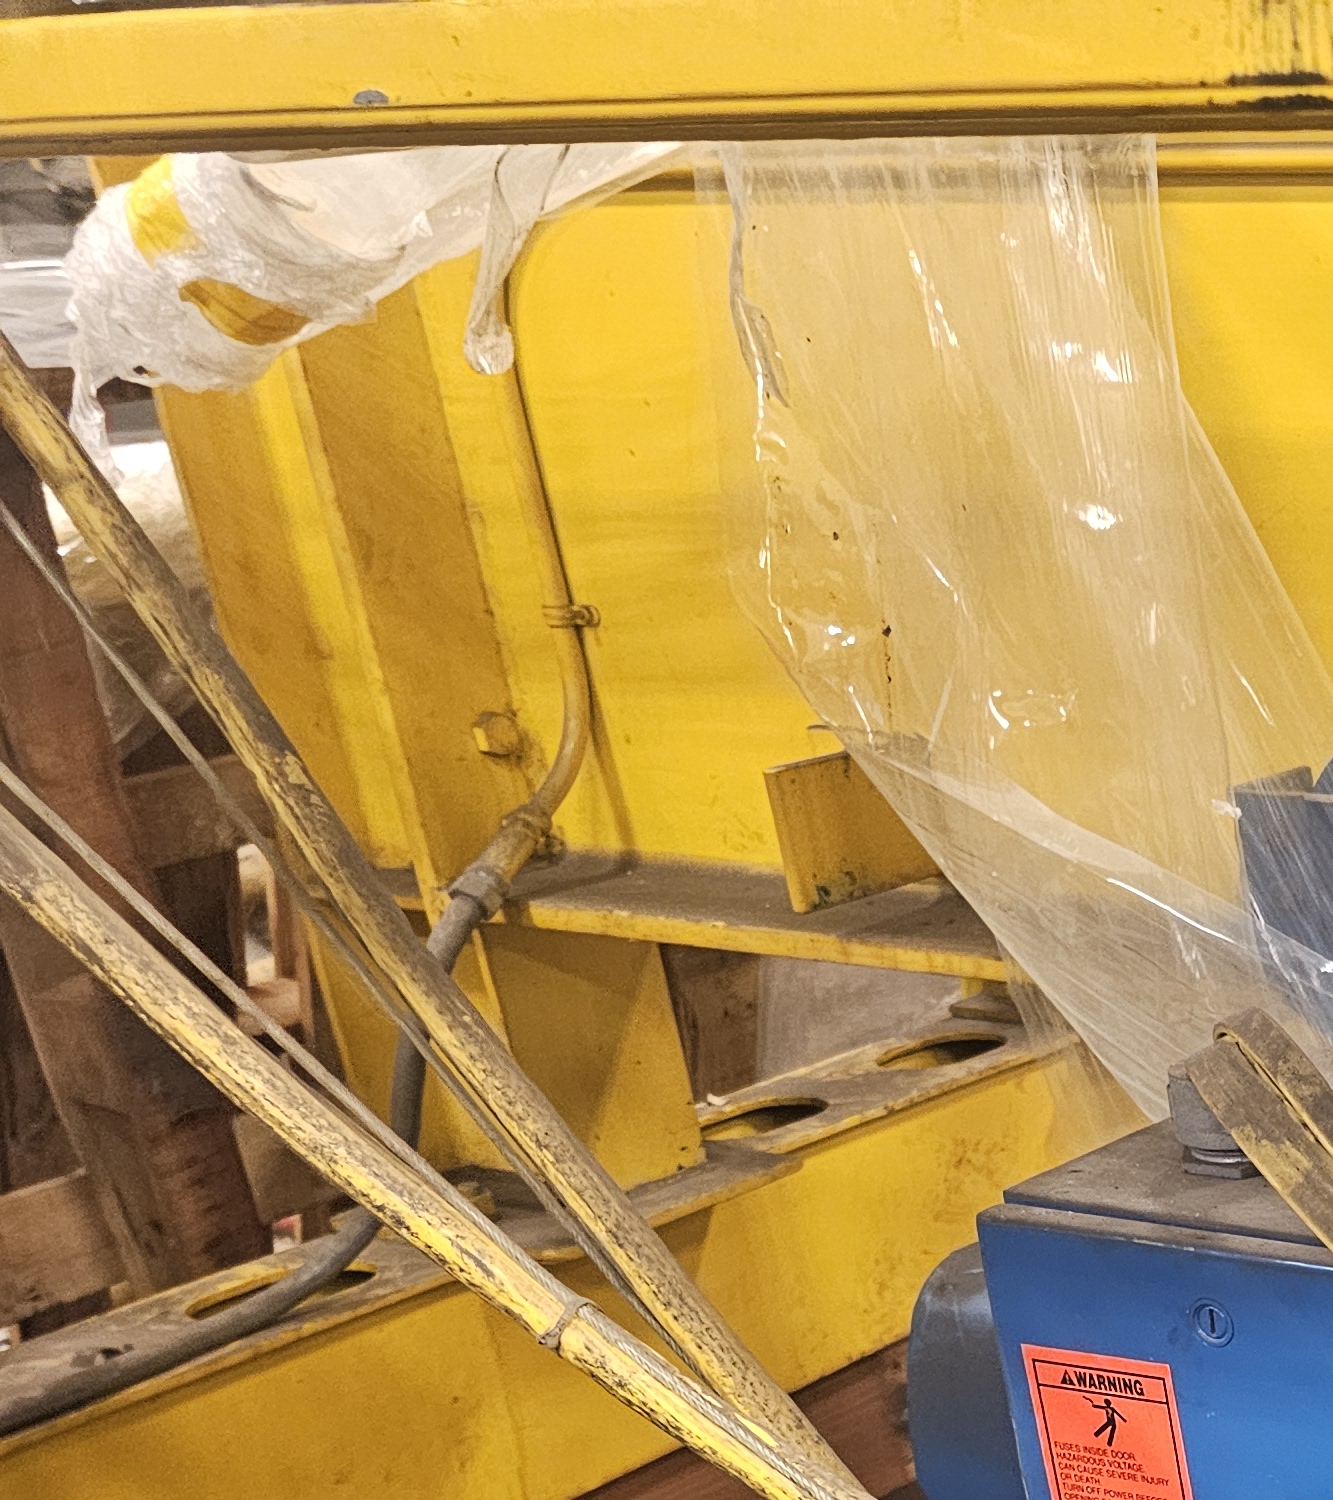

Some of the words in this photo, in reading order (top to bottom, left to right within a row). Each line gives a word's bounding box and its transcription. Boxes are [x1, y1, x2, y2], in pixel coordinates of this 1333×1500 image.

[1074, 1370, 1145, 1396] WARNING
[1054, 1441, 1080, 1452] FUSES
[1083, 1446, 1109, 1457] INSIDE
[1056, 1452, 1106, 1466] HAZARDOUS
[1059, 1462, 1075, 1471] CAN
[1077, 1465, 1104, 1476] CAUSE
[1106, 1469, 1138, 1482] SEVERE
[1141, 1475, 1169, 1486] INJURY
[1063, 1483, 1084, 1492] TURN
[1086, 1486, 1101, 1495] OFF
[1104, 1489, 1133, 1500] POWER
